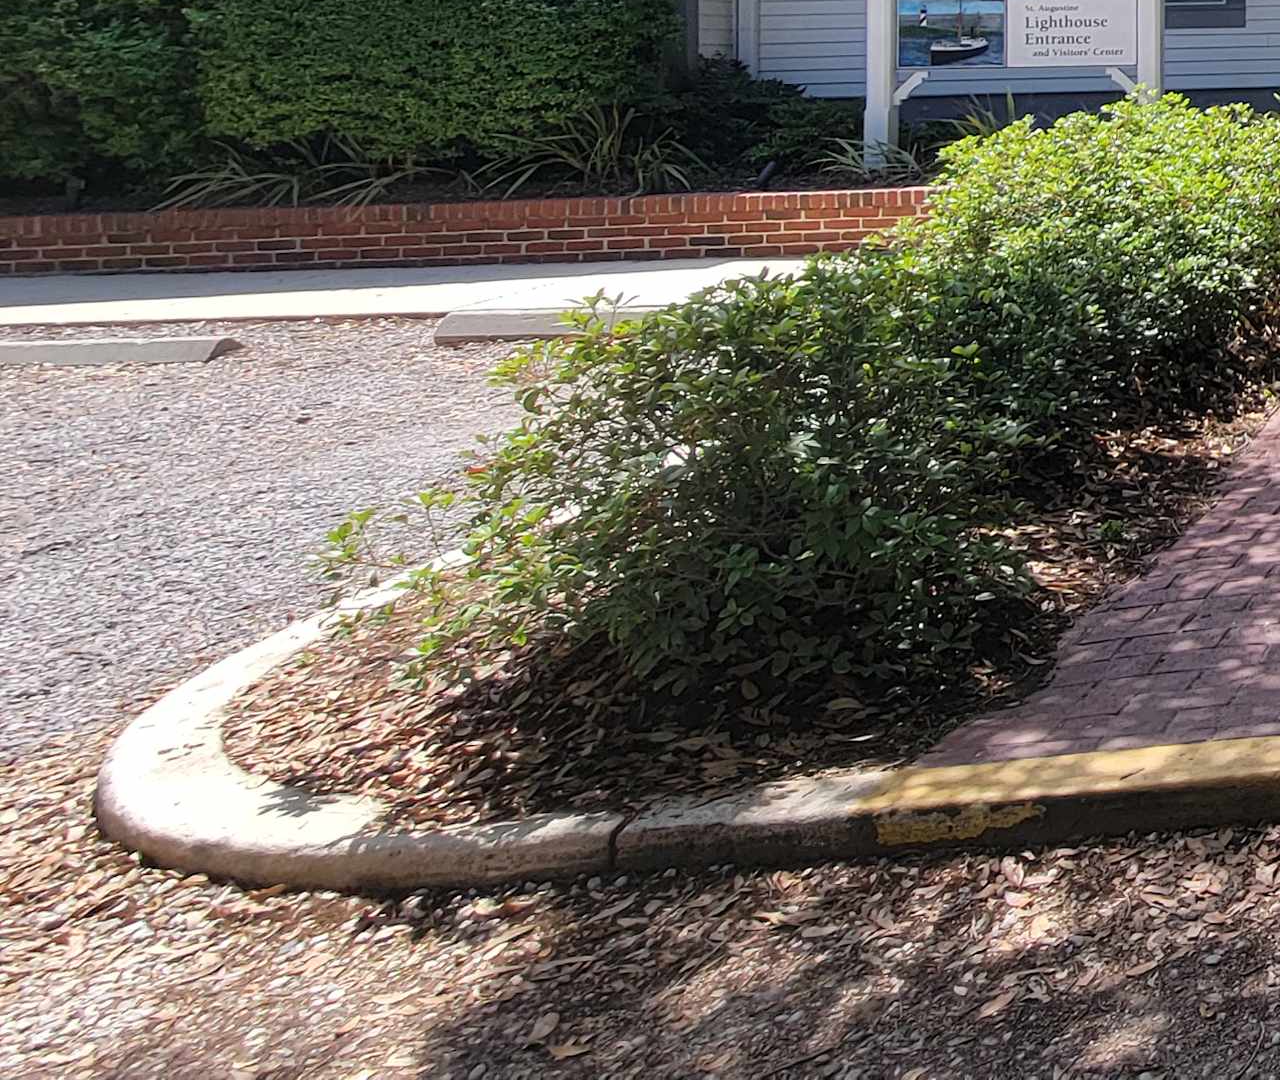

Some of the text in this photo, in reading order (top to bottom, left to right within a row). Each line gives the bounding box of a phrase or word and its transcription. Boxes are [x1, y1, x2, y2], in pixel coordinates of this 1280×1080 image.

[1038, 4, 1079, 13] Augustine
[1025, 15, 1108, 32] Lighthouse
[1025, 33, 1091, 45] Entrance
[1032, 47, 1124, 57] and Visitors' Center
